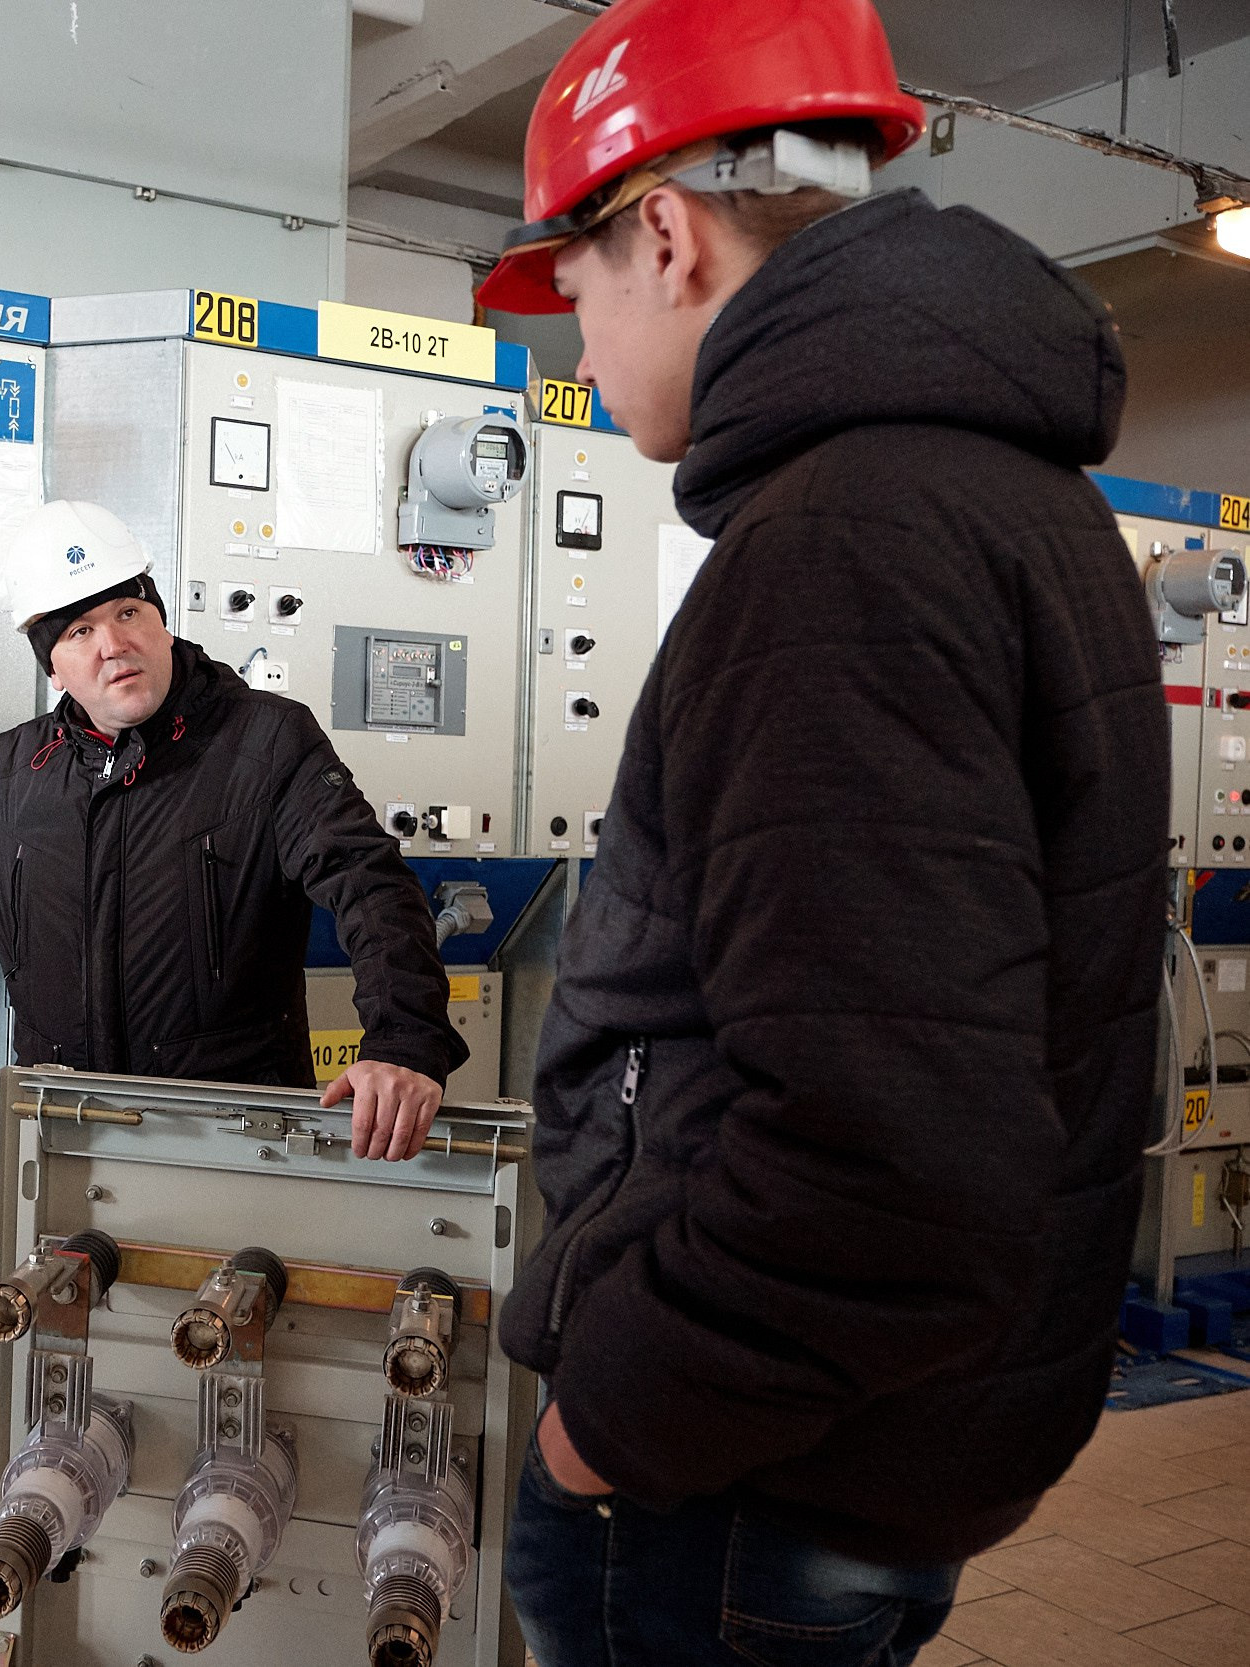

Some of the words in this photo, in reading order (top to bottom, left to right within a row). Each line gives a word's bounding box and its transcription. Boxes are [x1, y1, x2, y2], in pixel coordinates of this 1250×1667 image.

[195, 291, 255, 343] 208
[370, 326, 422, 355] 2В-10
[428, 335, 449, 358] 2Т
[544, 383, 591, 421] 207
[1221, 496, 1250, 530] 204
[338, 1044, 359, 1065] 2Т
[1186, 1097, 1214, 1125] 20
